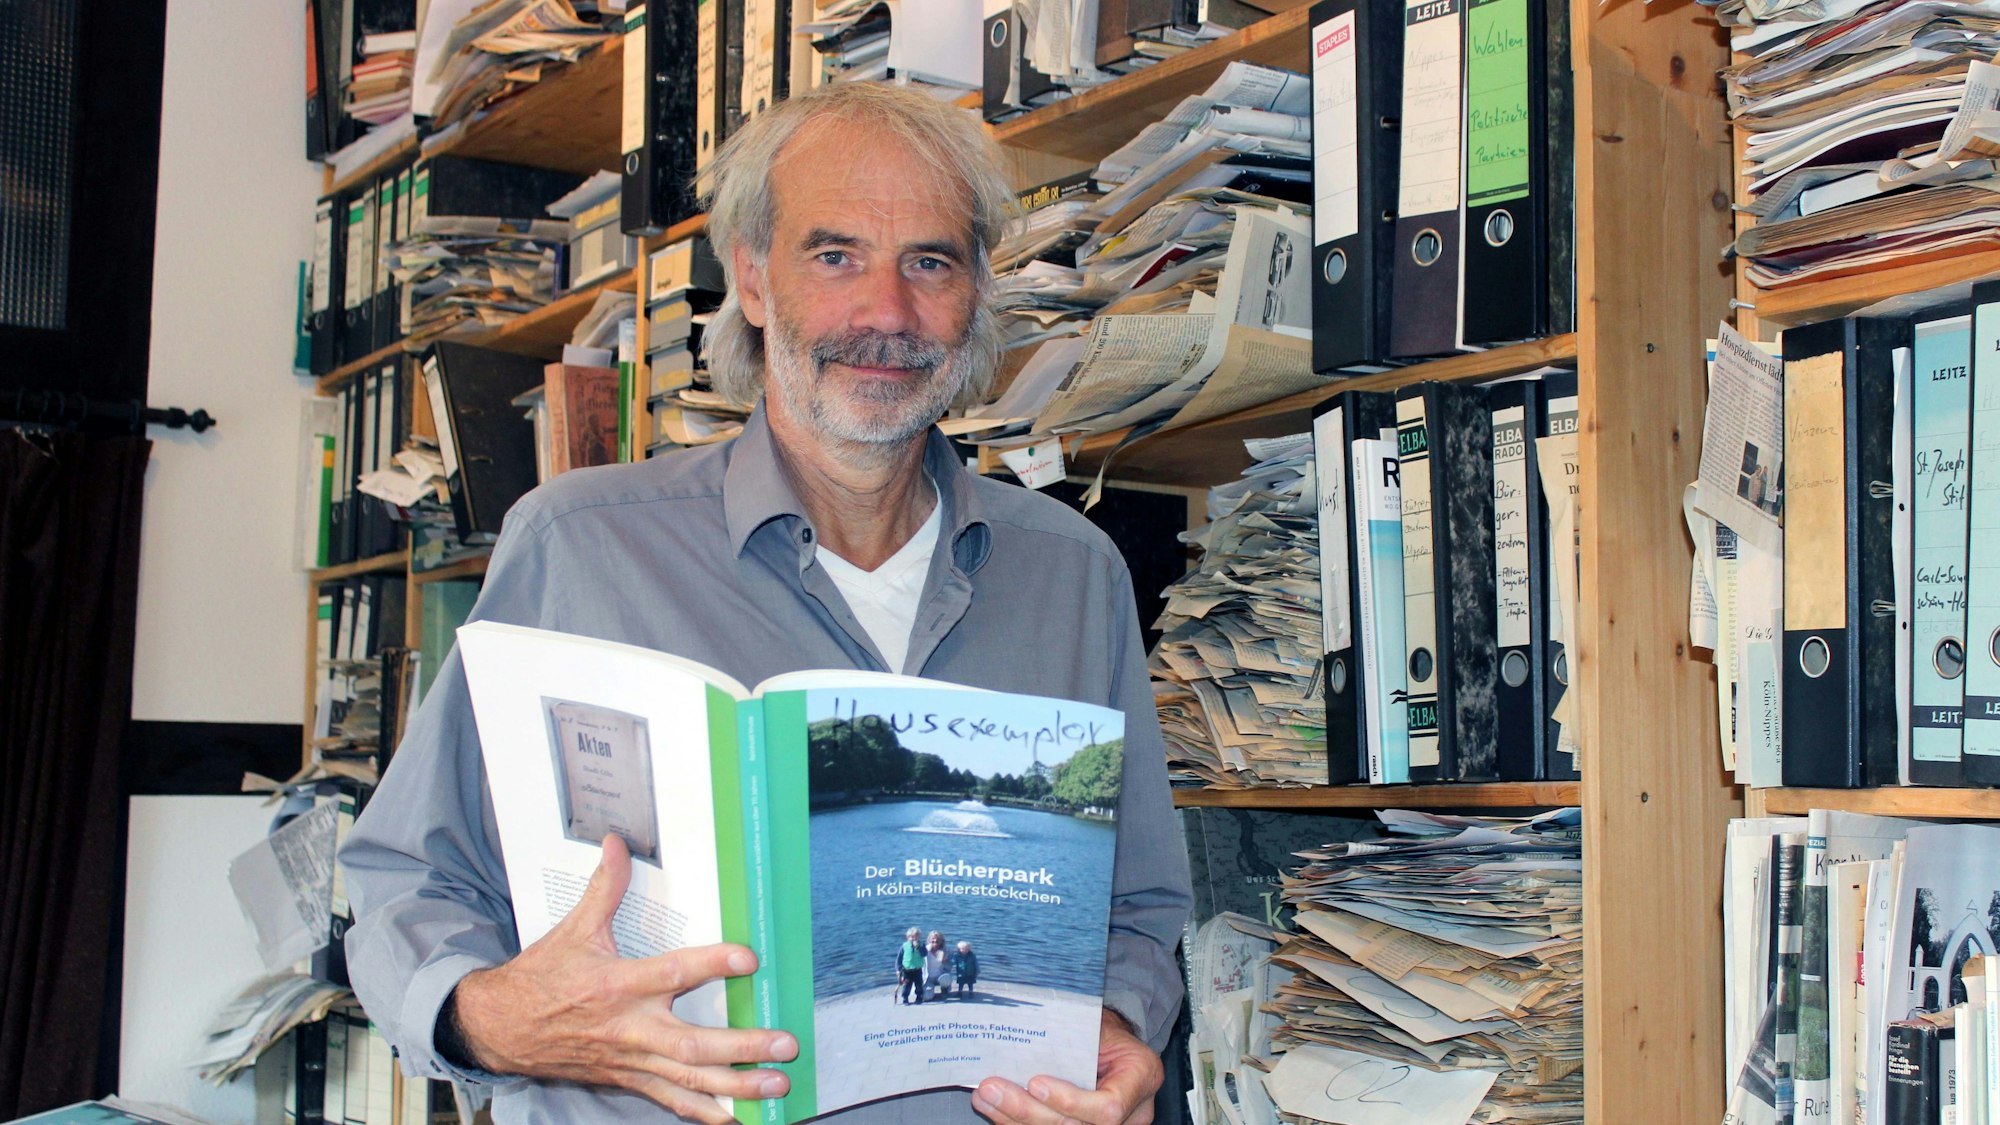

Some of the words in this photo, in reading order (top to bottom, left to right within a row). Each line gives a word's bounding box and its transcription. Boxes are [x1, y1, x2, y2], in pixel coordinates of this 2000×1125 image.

[1416, 0, 1451, 21] LEITZ
[1318, 30, 1349, 55] STAPLES
[1475, 19, 1524, 56] Wahlen
[1470, 104, 1528, 132] Politische
[1720, 332, 1767, 374] Hospizdienst
[1932, 365, 1967, 382] LEITZ
[1400, 431, 1427, 453] ELBA
[1494, 427, 1523, 446] ELBA
[1494, 444, 1523, 459] RADO
[1410, 707, 1437, 728] ELBA
[832, 697, 1107, 763] Hausexemplar
[577, 730, 613, 759] Akten
[865, 865, 896, 880] Der
[905, 859, 1054, 887] Blücherpark
[857, 885, 872, 899] in
[876, 881, 1062, 906] Köln-Bilderstöckchen
[864, 1029, 886, 1043] Eine
[887, 1023, 927, 1039] Chronik
[928, 1022, 947, 1032] mit
[948, 1021, 988, 1032] Photos,
[989, 1023, 1025, 1036] Fakten
[1026, 1027, 1047, 1038] und
[935, 1033, 954, 1041] aus
[955, 1031, 980, 1041] über
[981, 1031, 996, 1040] 111
[996, 1032, 1032, 1045] Jahren
